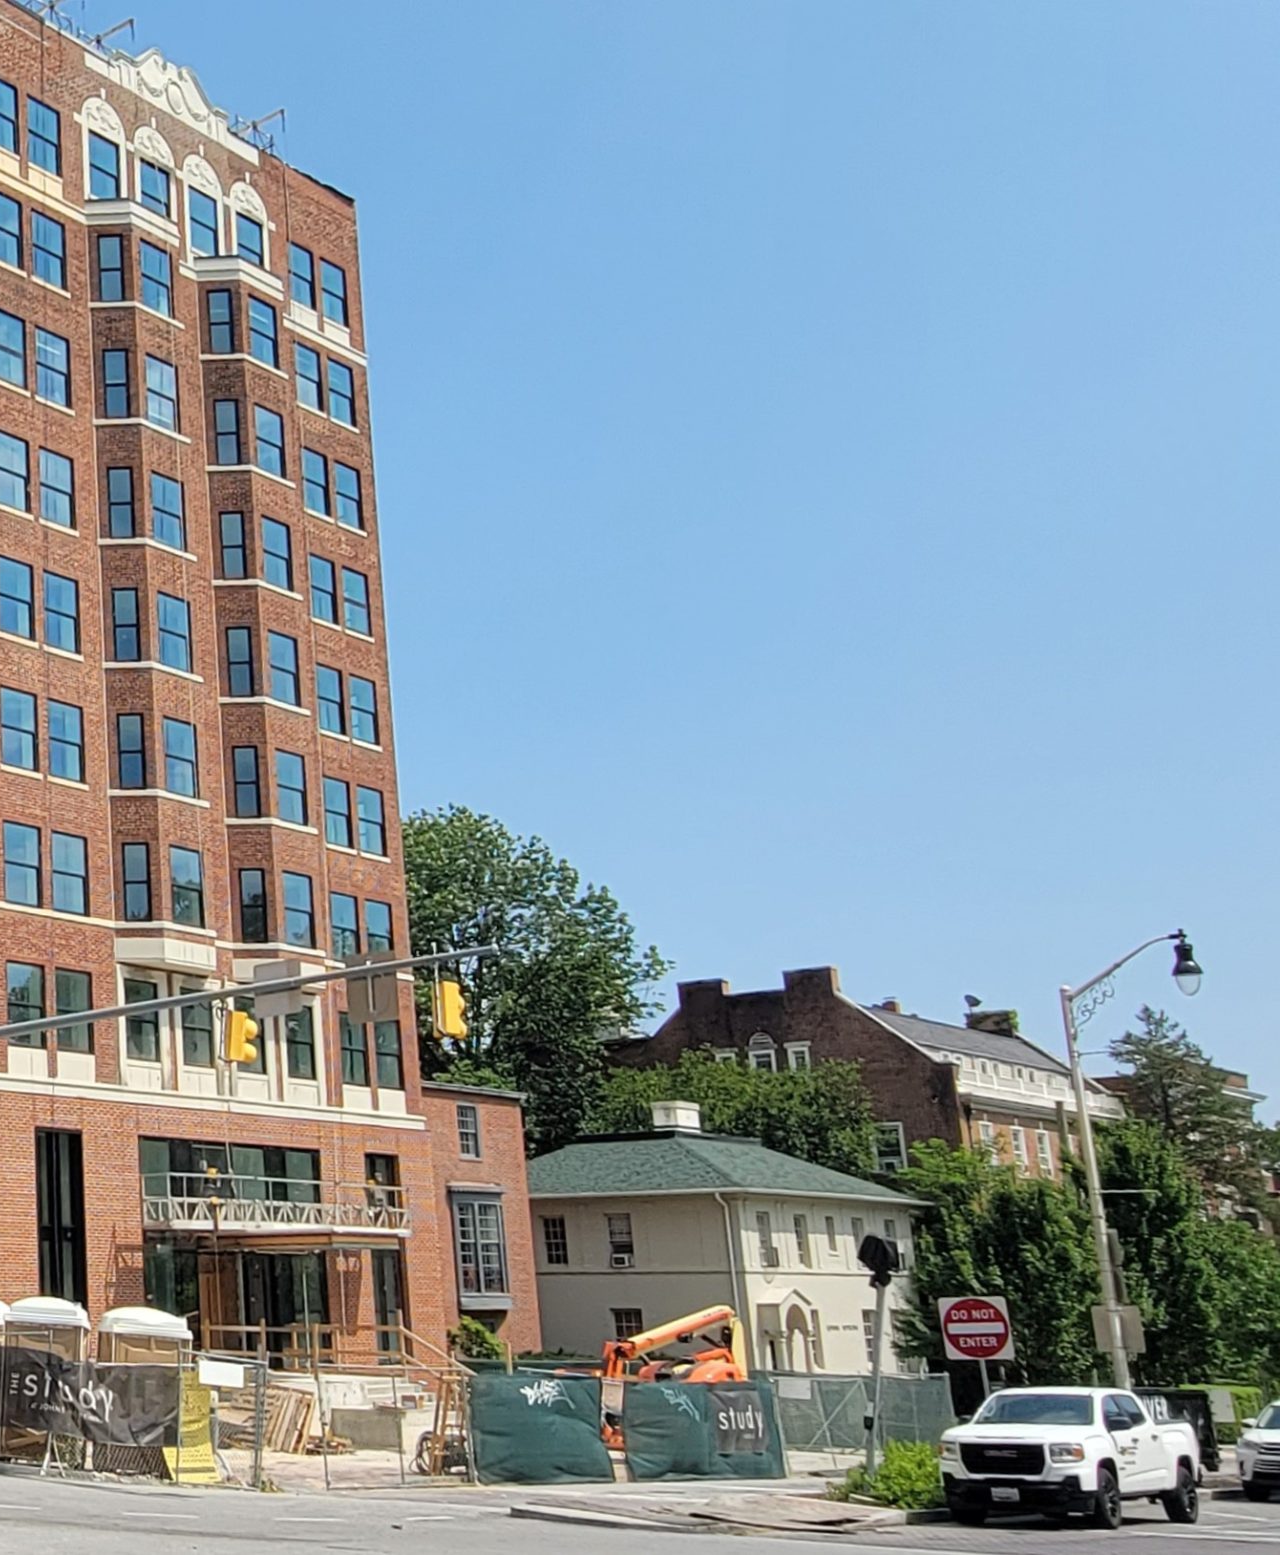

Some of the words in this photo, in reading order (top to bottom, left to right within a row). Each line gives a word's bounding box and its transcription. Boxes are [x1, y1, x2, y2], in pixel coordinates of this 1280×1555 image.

[950, 1309, 968, 1320] DO
[971, 1308, 996, 1320] NOT
[959, 1336, 998, 1348] ENTER
[9, 1372, 21, 1395] THE
[718, 1405, 763, 1438] study
